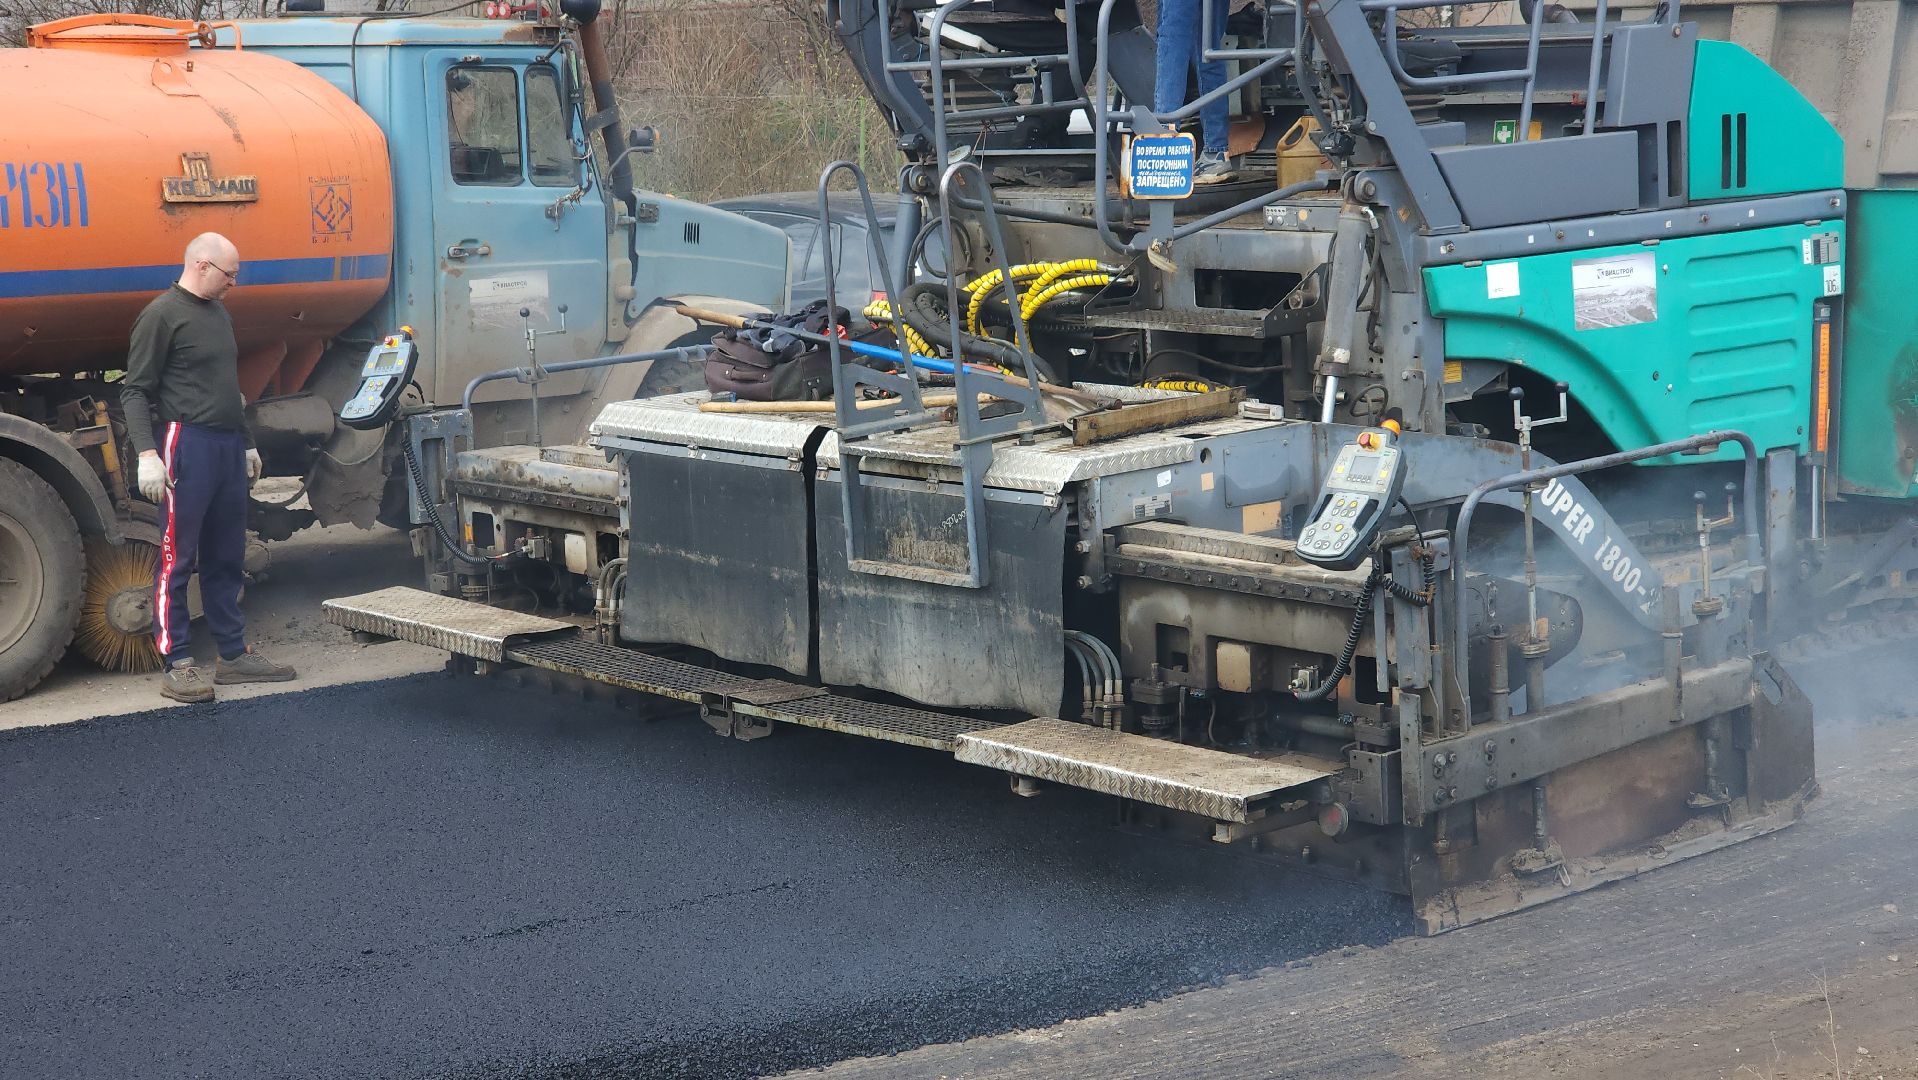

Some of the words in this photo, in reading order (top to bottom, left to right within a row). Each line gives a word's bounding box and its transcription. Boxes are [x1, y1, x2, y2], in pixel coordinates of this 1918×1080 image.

[1136, 146, 1144, 156] ВО
[1145, 146, 1166, 156] ВРЕМЯ
[1168, 145, 1190, 155] РАБОТЫ
[1137, 159, 1188, 170] ПОСТОРОННИМ
[1136, 176, 1187, 188] ЗАПРЕЩЕНО
[1605, 267, 1634, 276] ВИАСТРОЙ
[1533, 478, 1594, 545] UPER
